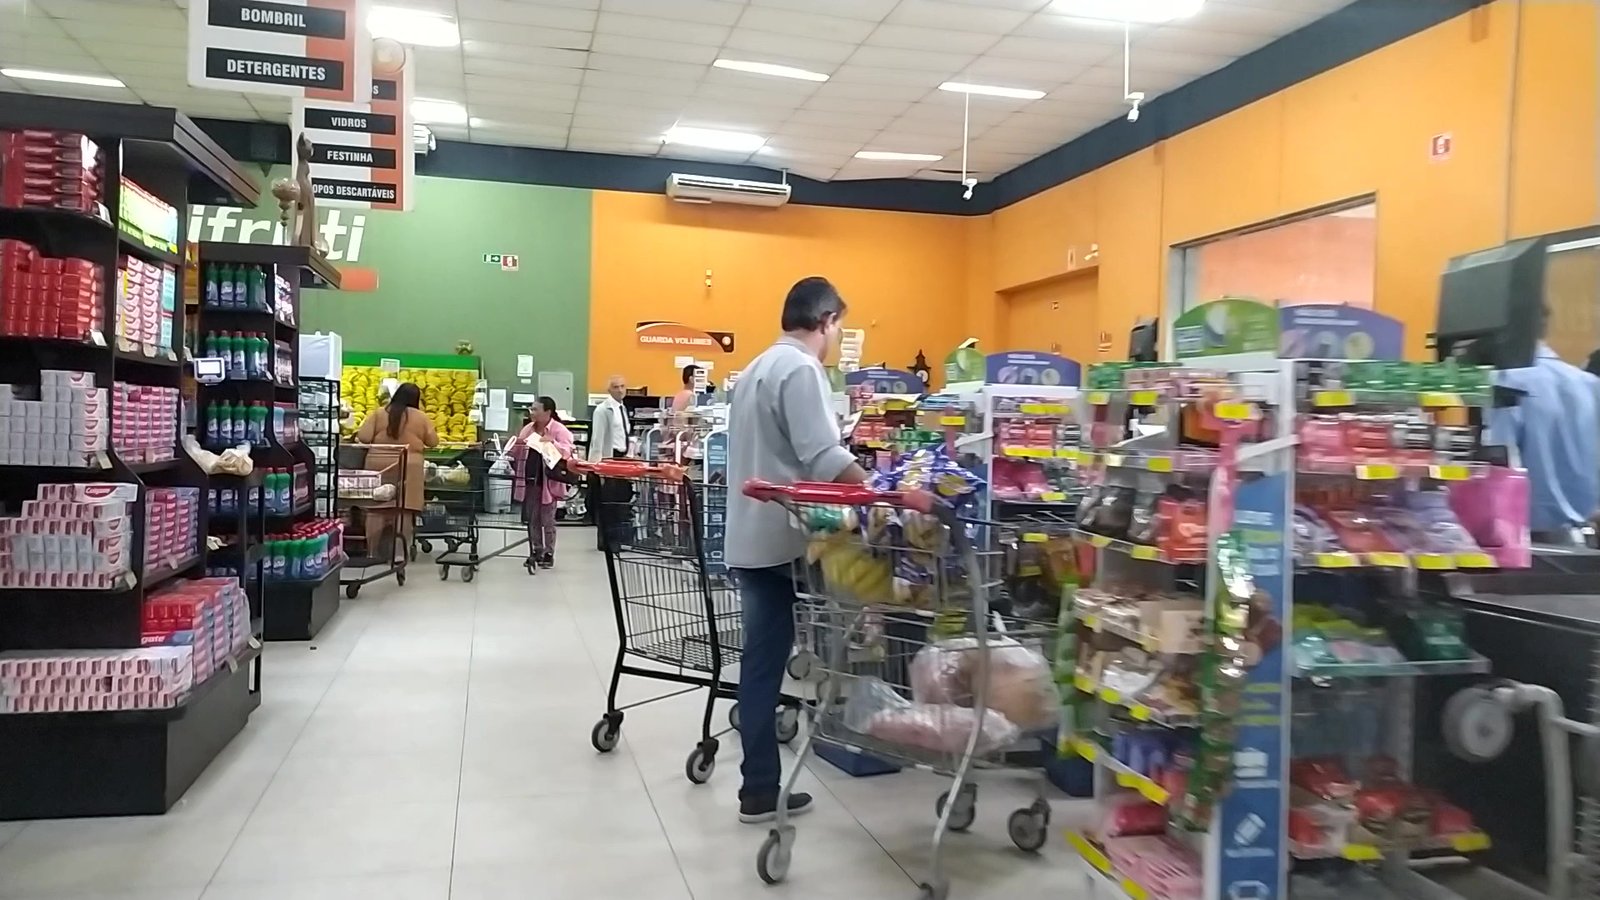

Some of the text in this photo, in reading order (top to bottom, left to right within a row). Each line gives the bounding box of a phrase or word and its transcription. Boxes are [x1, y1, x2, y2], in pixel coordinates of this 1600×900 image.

[241, 7, 307, 28] BOMBRIL
[226, 59, 326, 81] DETERGENTES
[331, 116, 367, 128] VIDROS
[327, 150, 373, 163] FESTINHA
[312, 183, 395, 199] OPOS DESCARTÁVEIS
